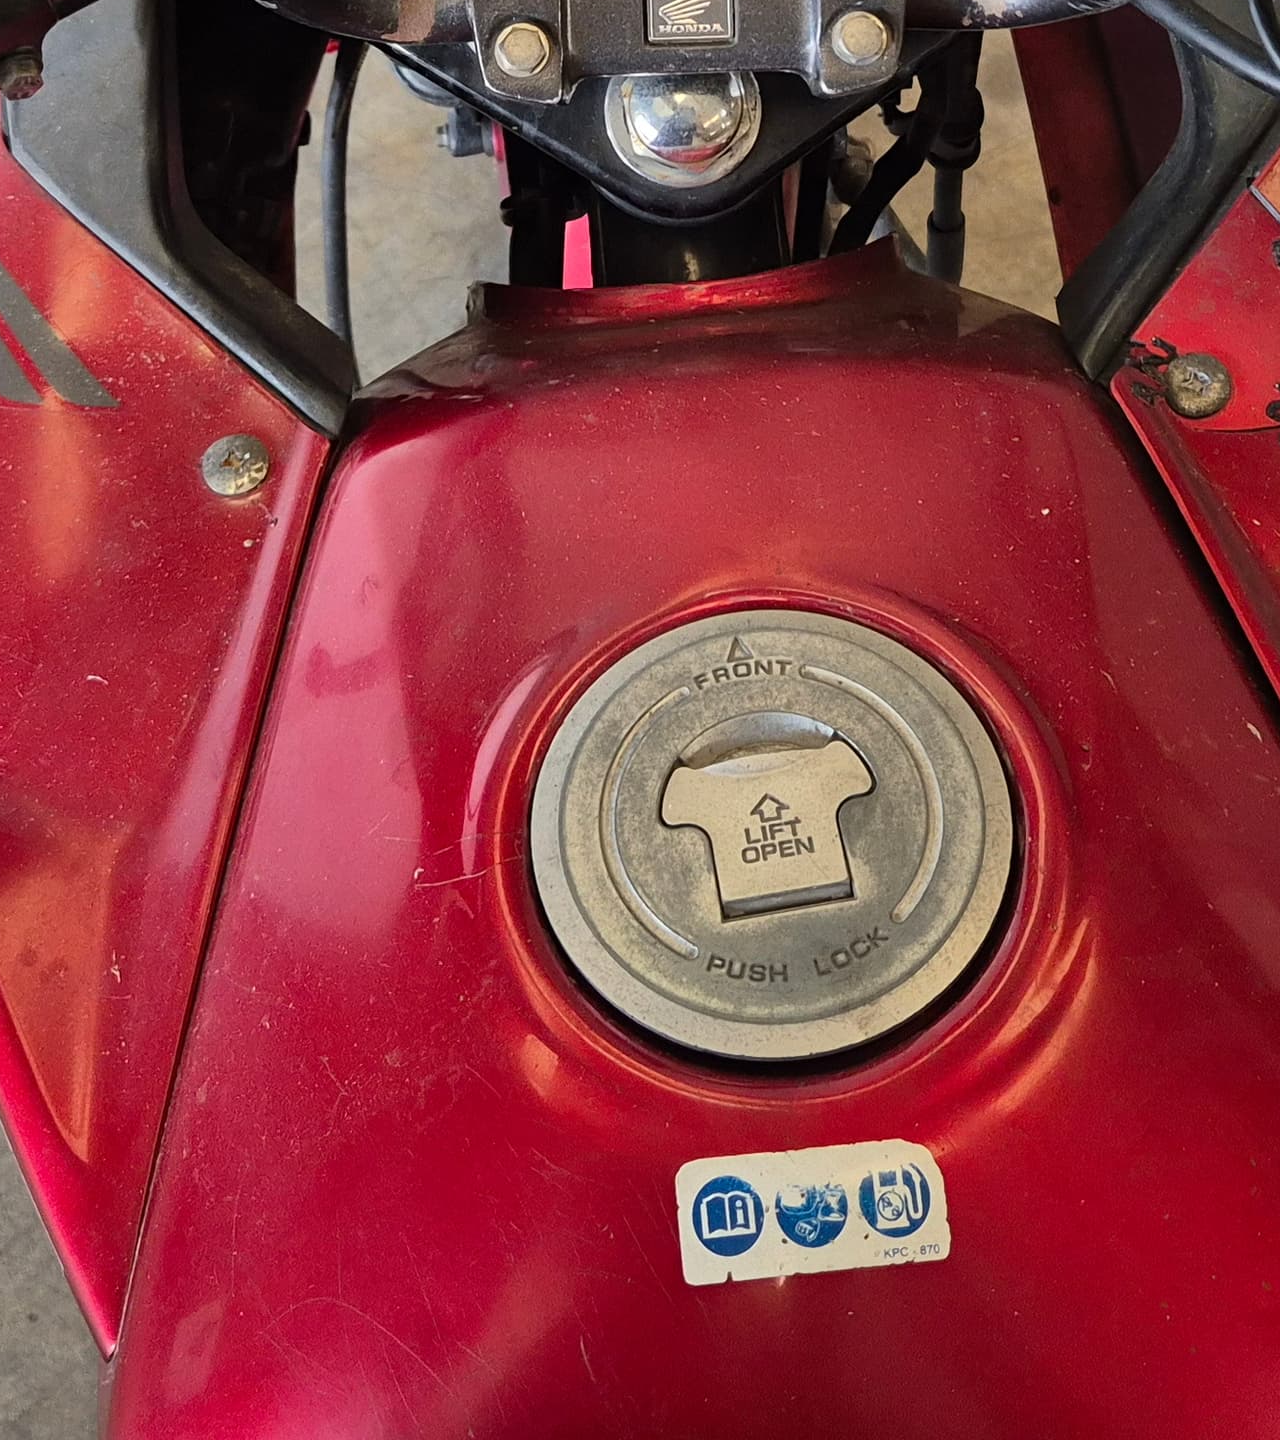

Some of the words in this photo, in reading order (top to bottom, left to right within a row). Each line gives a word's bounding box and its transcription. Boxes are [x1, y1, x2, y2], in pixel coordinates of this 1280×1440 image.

[658, 23, 725, 34] HONDA
[693, 659, 793, 690] FRONT
[744, 817, 802, 844] LIFT
[741, 835, 816, 865] OPEN
[706, 953, 789, 983] PUSH
[812, 931, 889, 976] LOCK
[883, 1246, 909, 1258] KPC
[919, 1243, 941, 1255] 870
